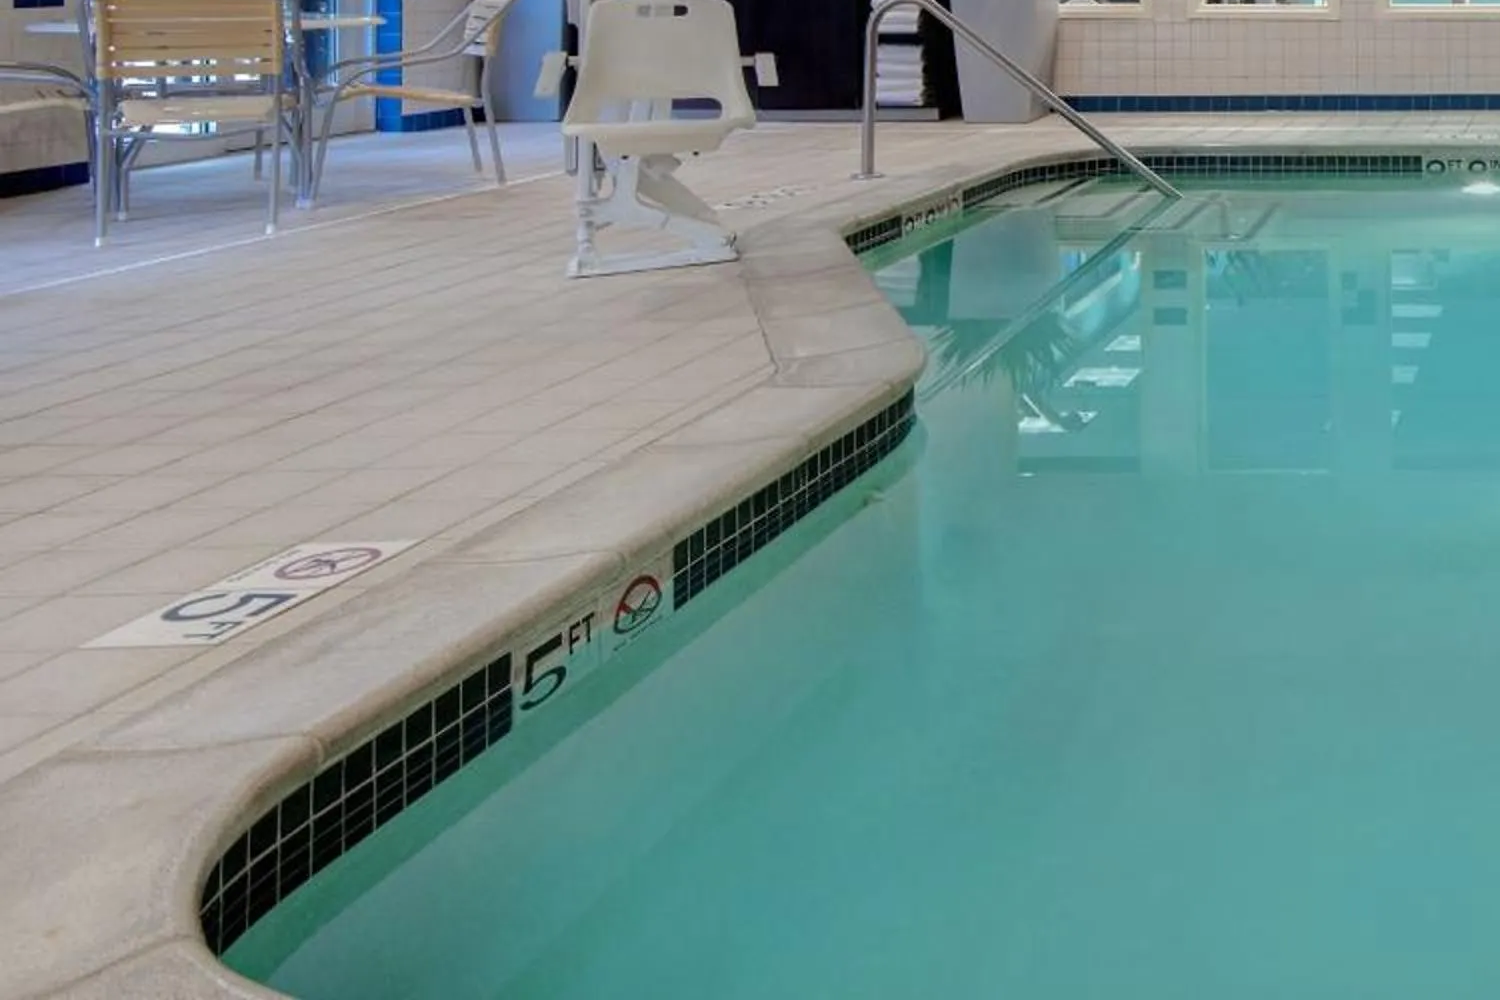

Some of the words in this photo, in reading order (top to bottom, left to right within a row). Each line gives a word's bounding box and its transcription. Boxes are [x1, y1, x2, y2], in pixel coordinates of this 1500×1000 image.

[1447, 159, 1464, 170] FT
[161, 593, 299, 622] 5
[183, 621, 244, 640] FT
[520, 632, 567, 711] 5
[569, 612, 595, 655] FT
